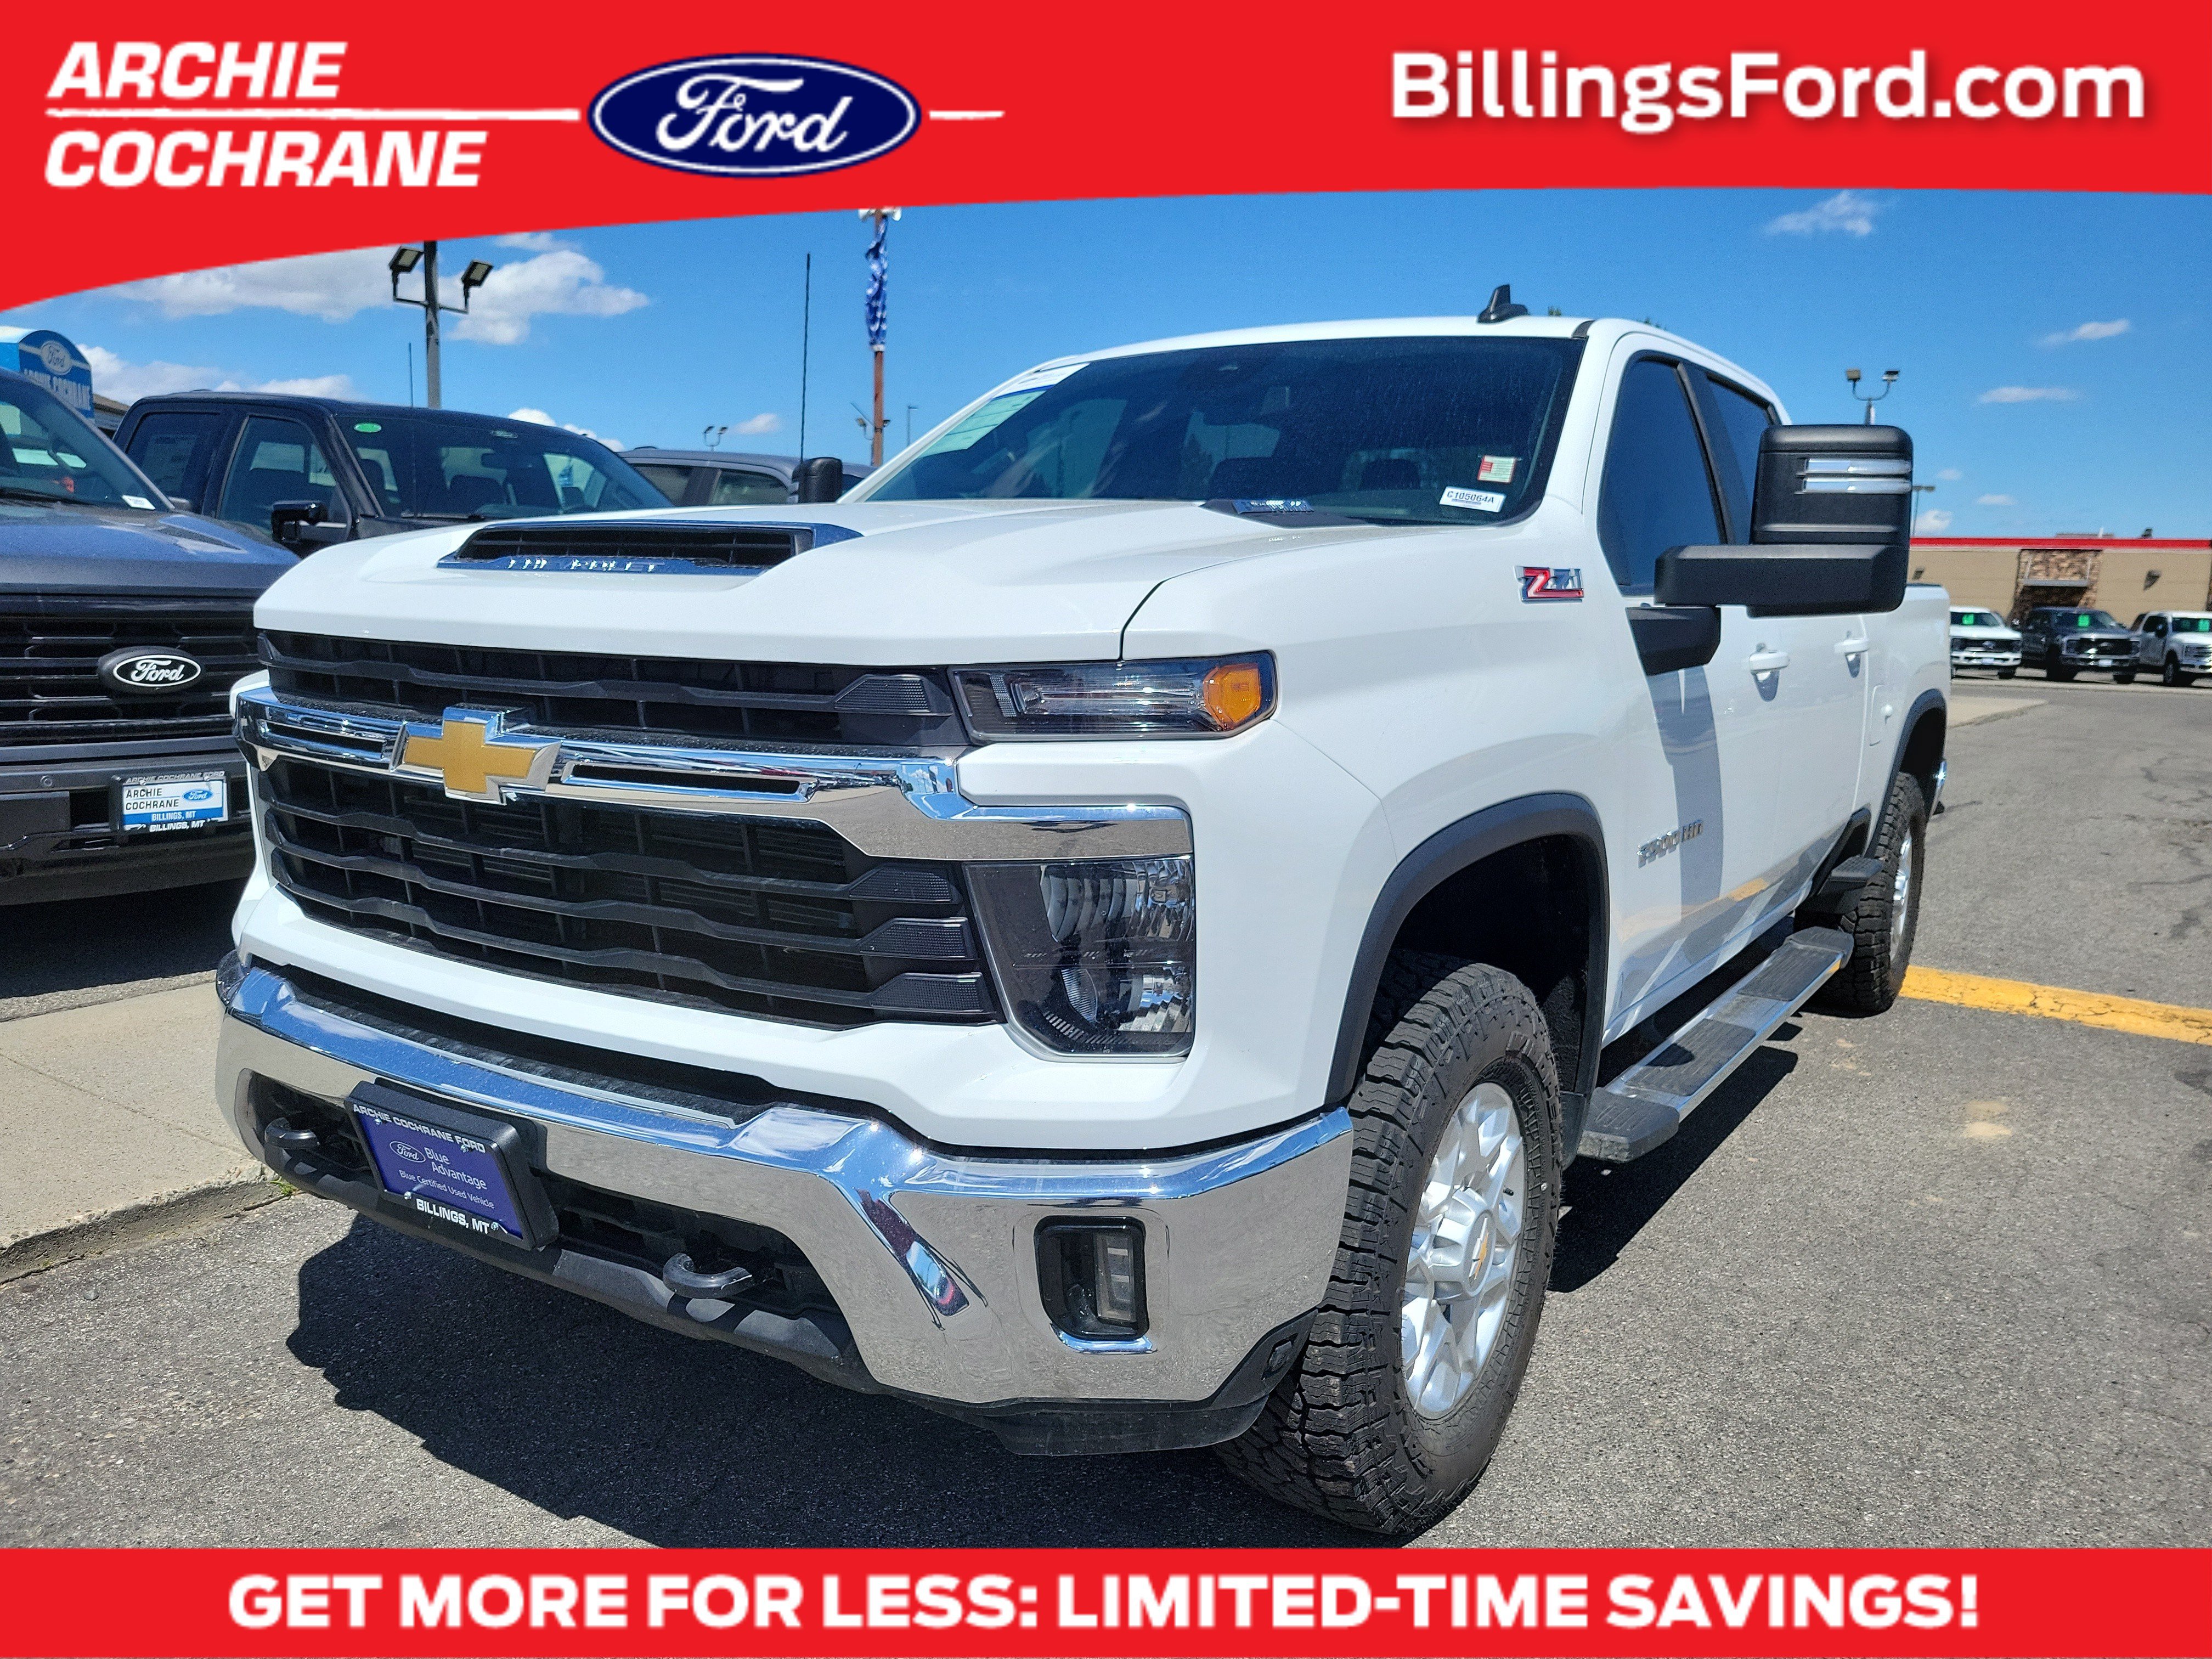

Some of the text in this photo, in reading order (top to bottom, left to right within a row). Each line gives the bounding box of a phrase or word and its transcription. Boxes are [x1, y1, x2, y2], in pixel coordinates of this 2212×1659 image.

[1447, 490, 1494, 504] C105064A
[131, 658, 185, 682] Ford
[157, 772, 202, 781] COCHRANE
[126, 788, 162, 798] ARCHIE
[188, 791, 208, 800] Ford
[126, 799, 179, 810] COCHRANE
[151, 810, 196, 822] BILLINGS, MT
[149, 820, 206, 833] BILLINGS, MT
[353, 1104, 486, 1153] ARCHIE COCHRANE FORD
[397, 1143, 450, 1165] Ford Blue
[432, 1161, 487, 1190] Advantage
[399, 1170, 495, 1209] Blue Certified Used Vehicle
[416, 1198, 490, 1234] BILLINGS, MT
